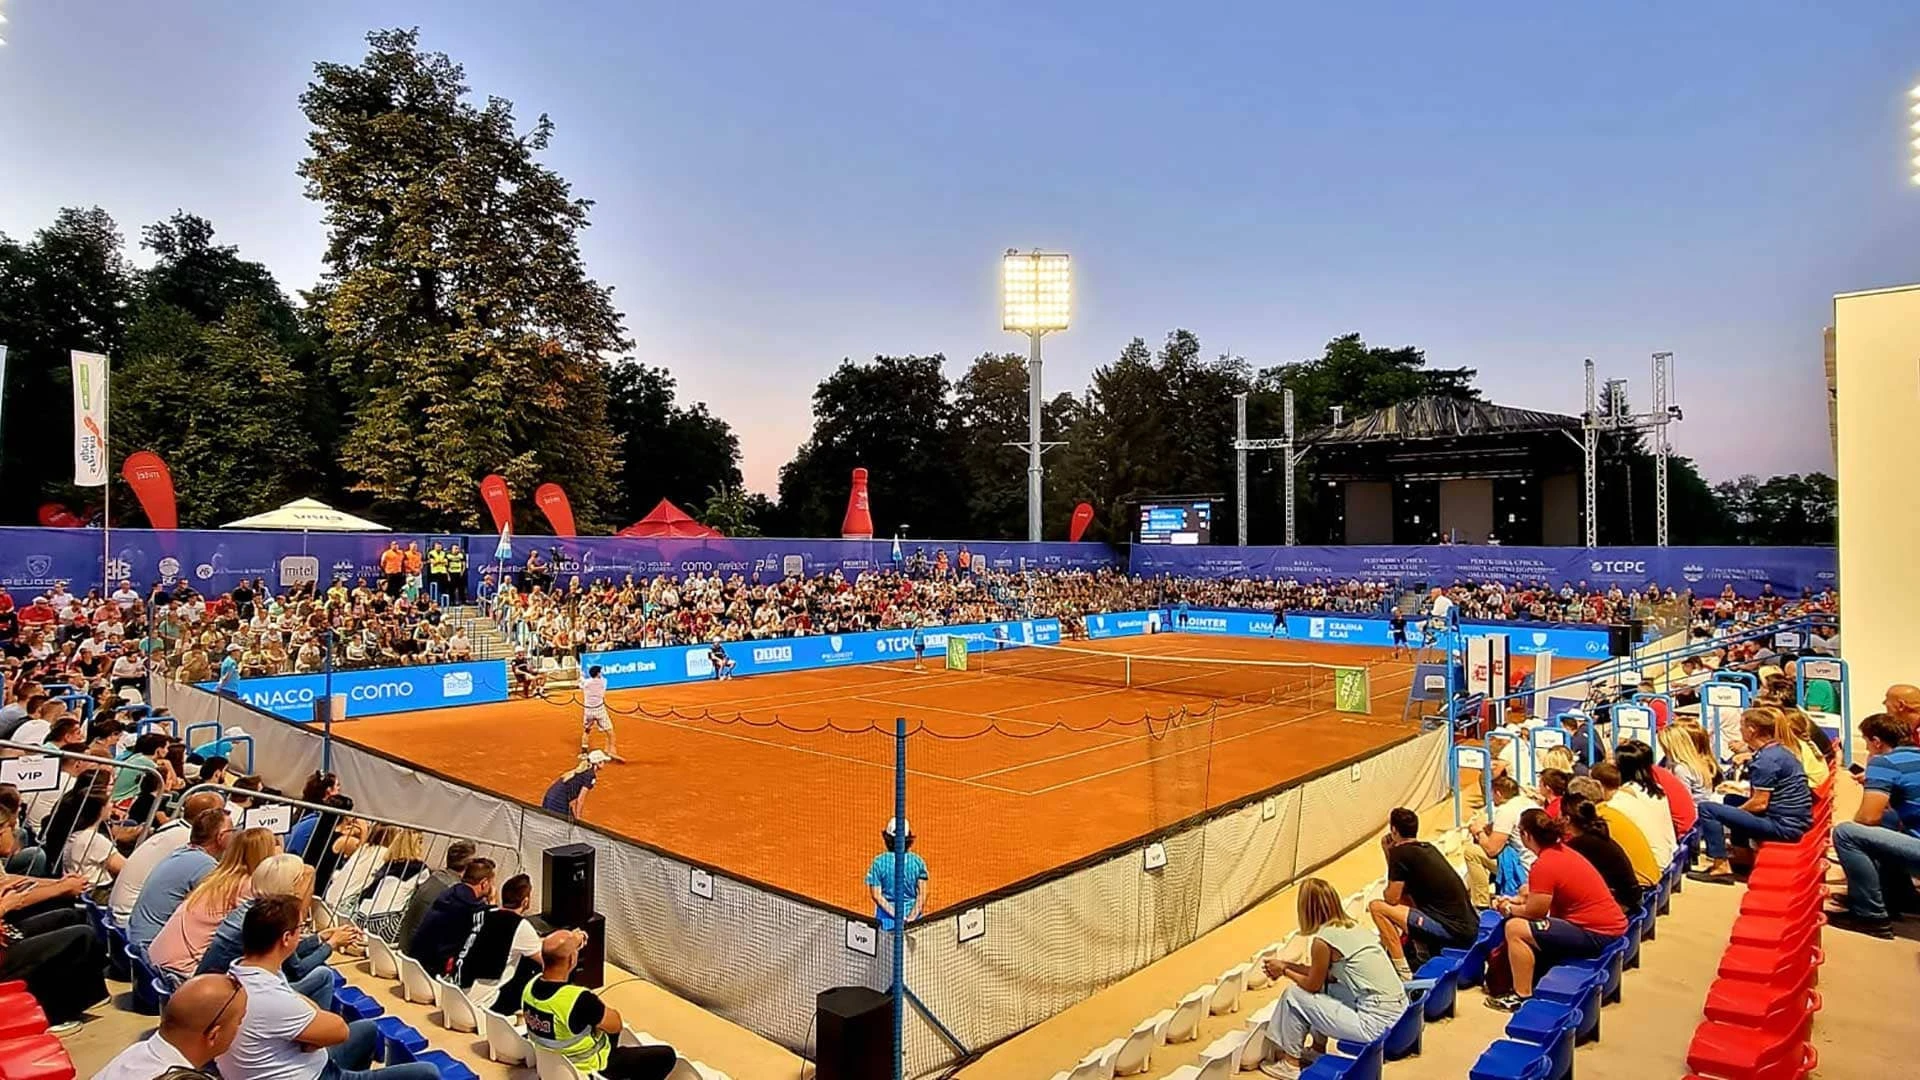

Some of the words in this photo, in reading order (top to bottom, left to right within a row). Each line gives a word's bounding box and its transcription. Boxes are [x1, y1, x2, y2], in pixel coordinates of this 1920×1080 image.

[1604, 561, 1645, 573] TCPC
[637, 660, 657, 672] Bank
[241, 688, 314, 706] ANACO
[17, 771, 42, 780] VIP
[259, 818, 278, 826] VIP
[966, 921, 979, 930] VIP
[854, 934, 868, 944] VIP
